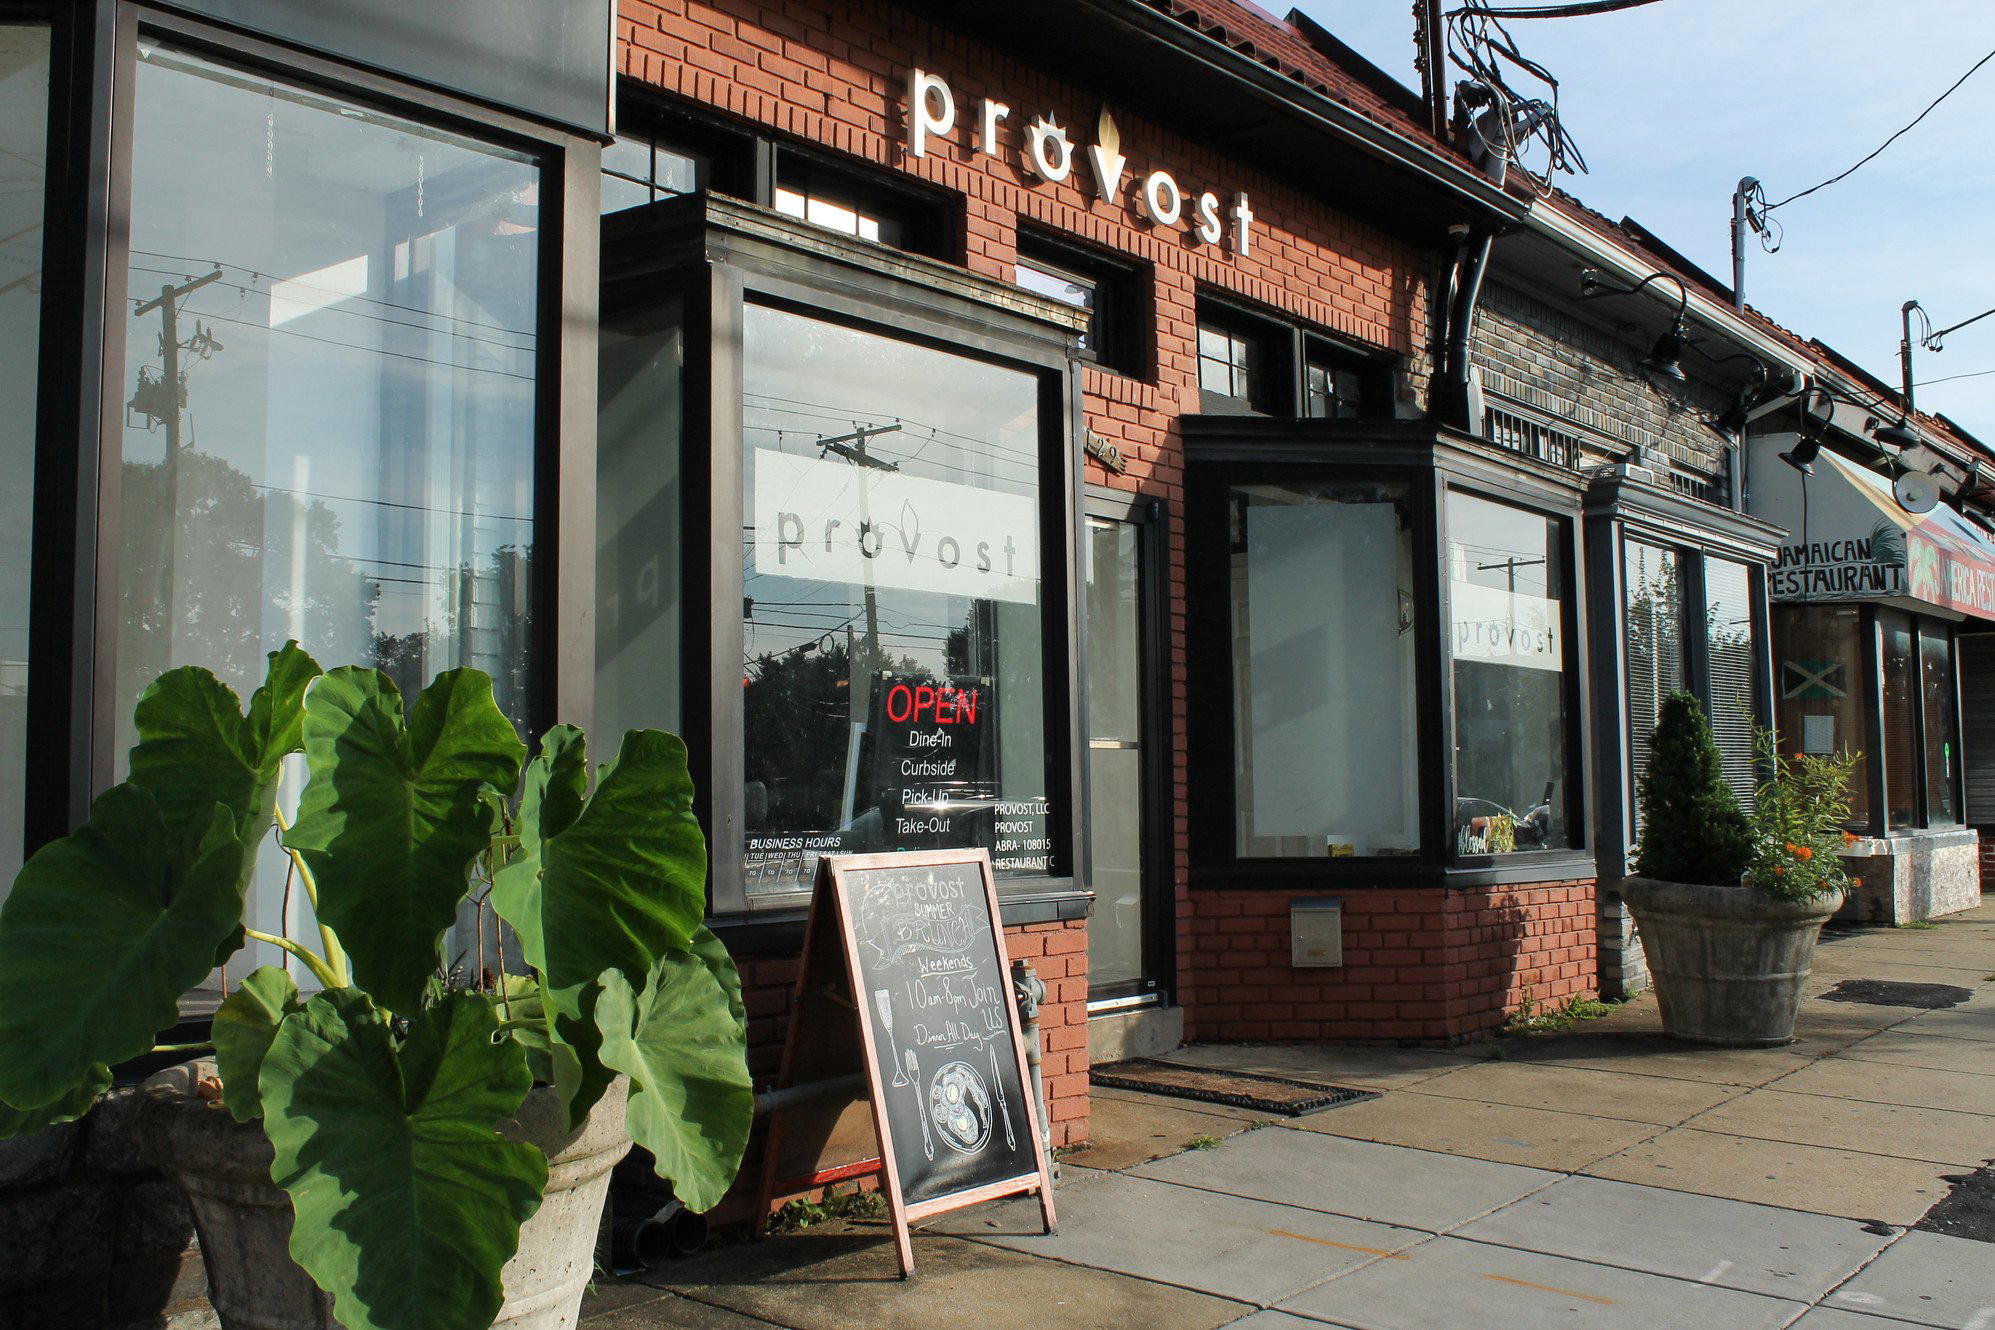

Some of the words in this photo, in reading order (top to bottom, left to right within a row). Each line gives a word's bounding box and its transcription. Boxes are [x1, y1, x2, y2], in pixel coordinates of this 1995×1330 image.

[908, 68, 1253, 257] provost
[777, 511, 1016, 576] provost
[1771, 538, 1871, 569] JAMAICAN
[1457, 618, 1554, 654] provost
[887, 685, 978, 725] OPEN
[909, 730, 953, 748] Dine-In
[901, 759, 956, 777] Curbside
[902, 788, 950, 808] Pick-Up
[1035, 802, 1050, 815] LLC
[896, 817, 951, 835] Take-Out
[994, 820, 1034, 834] PROVOST
[749, 838, 804, 850] BUSINESS
[804, 836, 842, 849] HOURS
[1022, 838, 1051, 851] 108015
[750, 852, 764, 860] TUE
[768, 852, 784, 860] WED
[787, 851, 801, 860] THU
[995, 855, 1048, 870] RESTAURANT
[914, 901, 956, 921] SUMMER
[896, 911, 978, 948] BRUNCH
[917, 955, 974, 974] Weekends
[962, 971, 1001, 1009] Join
[946, 1020, 961, 1043] All
